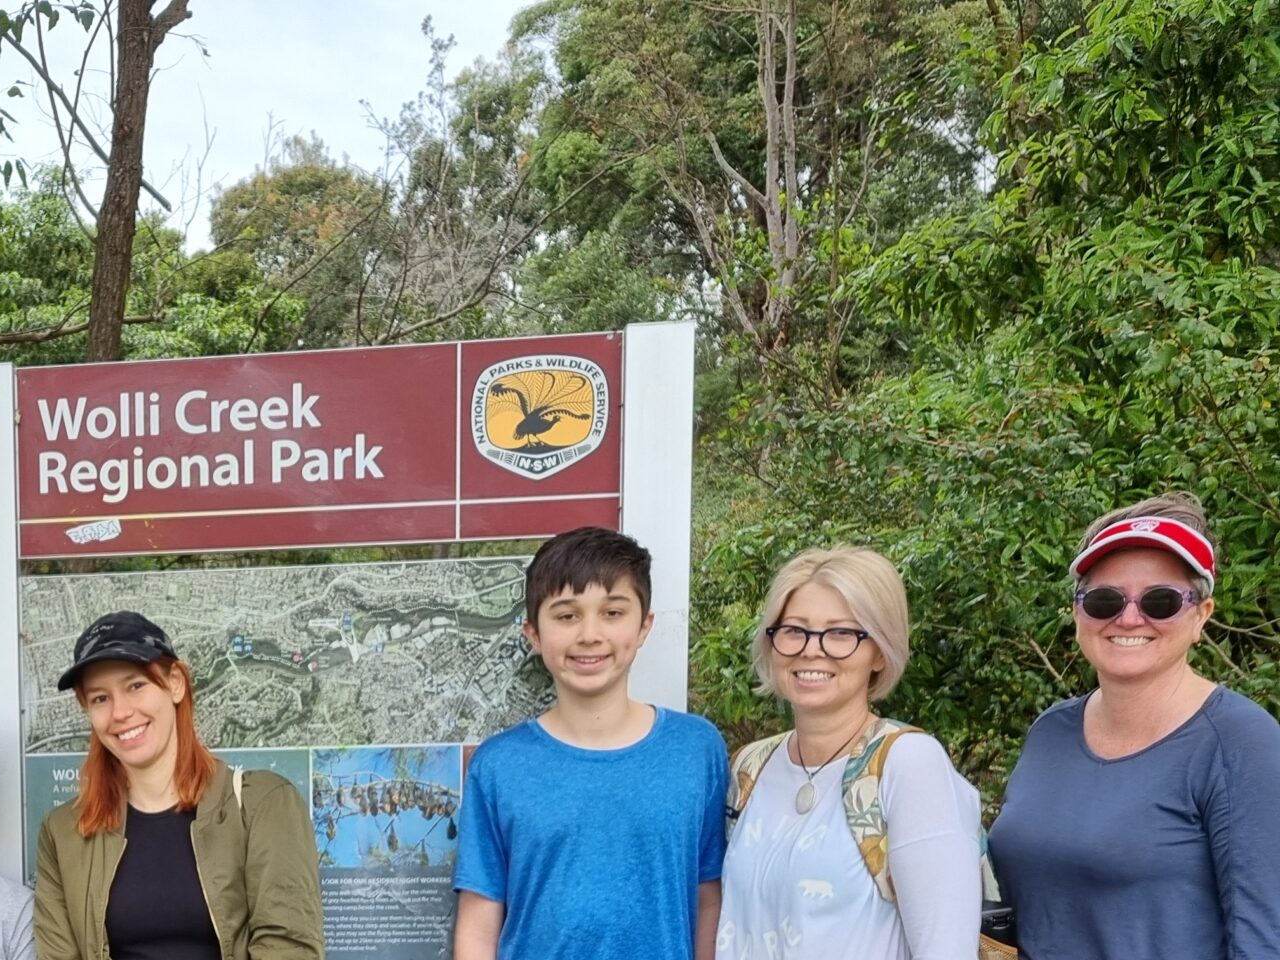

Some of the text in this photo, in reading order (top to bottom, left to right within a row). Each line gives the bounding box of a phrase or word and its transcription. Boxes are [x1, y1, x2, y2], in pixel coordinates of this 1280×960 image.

[37, 382, 321, 441] Wolli Creek
[474, 358, 605, 444] NATIONAL PARKS & WILDLIFE SERVICE
[38, 433, 384, 503] Regional Park
[61, 782, 80, 793] refu
